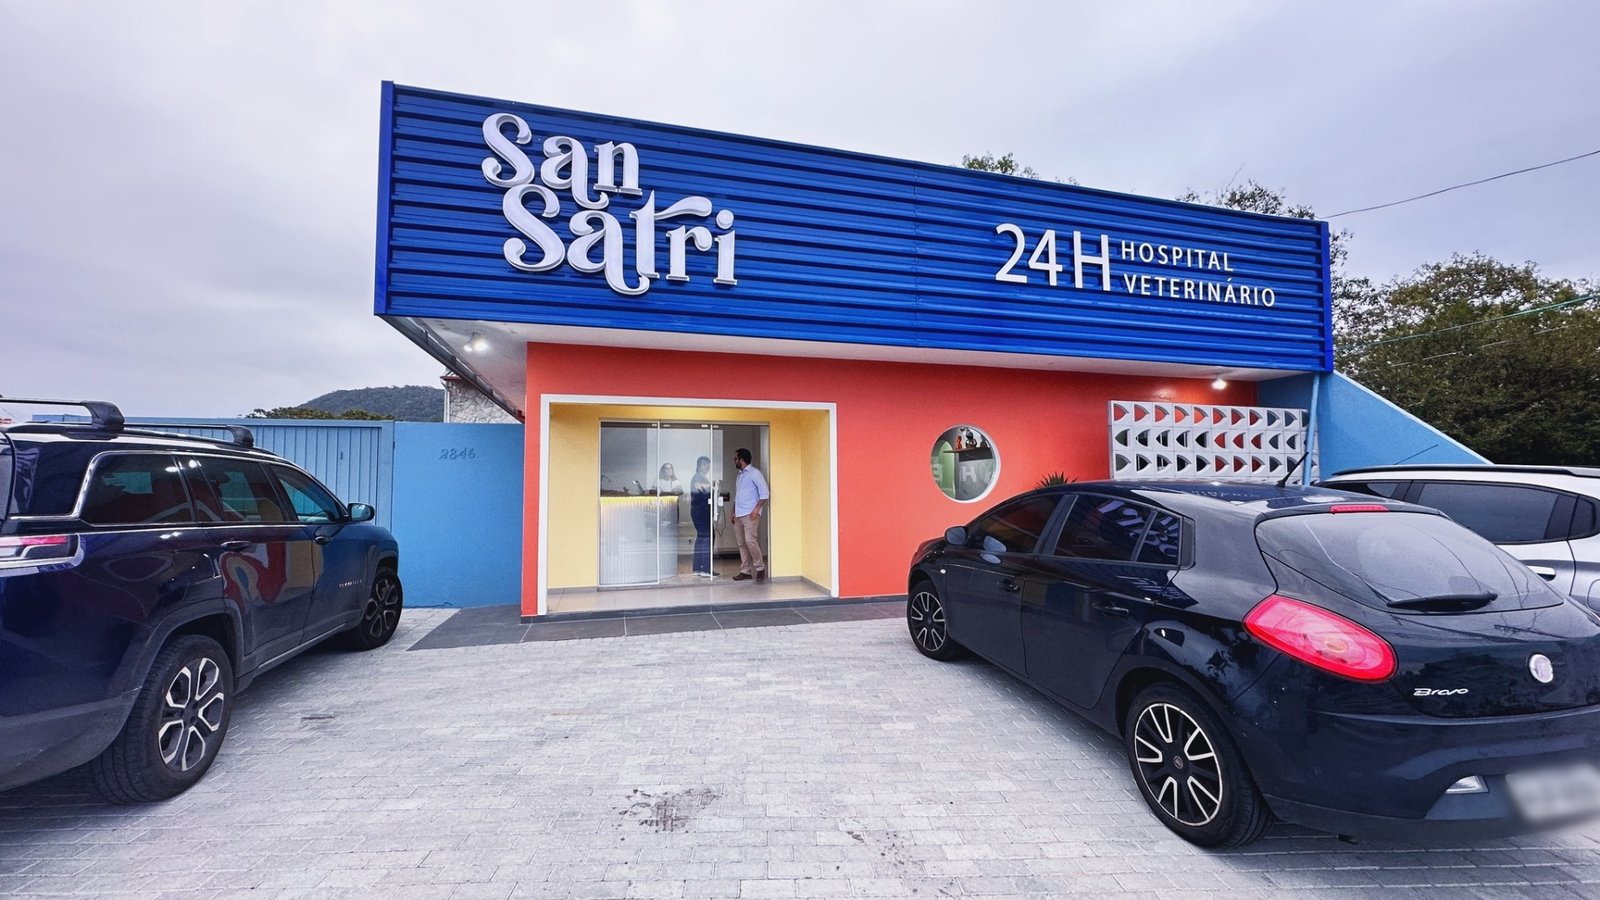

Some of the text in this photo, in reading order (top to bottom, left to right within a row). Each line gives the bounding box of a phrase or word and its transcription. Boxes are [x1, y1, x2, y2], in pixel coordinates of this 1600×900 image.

[481, 112, 643, 210] San
[502, 184, 738, 296] Satri
[1121, 240, 1234, 272] HOSPITAL
[994, 223, 1112, 292] 24H
[1123, 273, 1276, 307] VETERINÁRIO
[438, 447, 476, 460] 2846
[1413, 687, 1469, 697] Bravo
